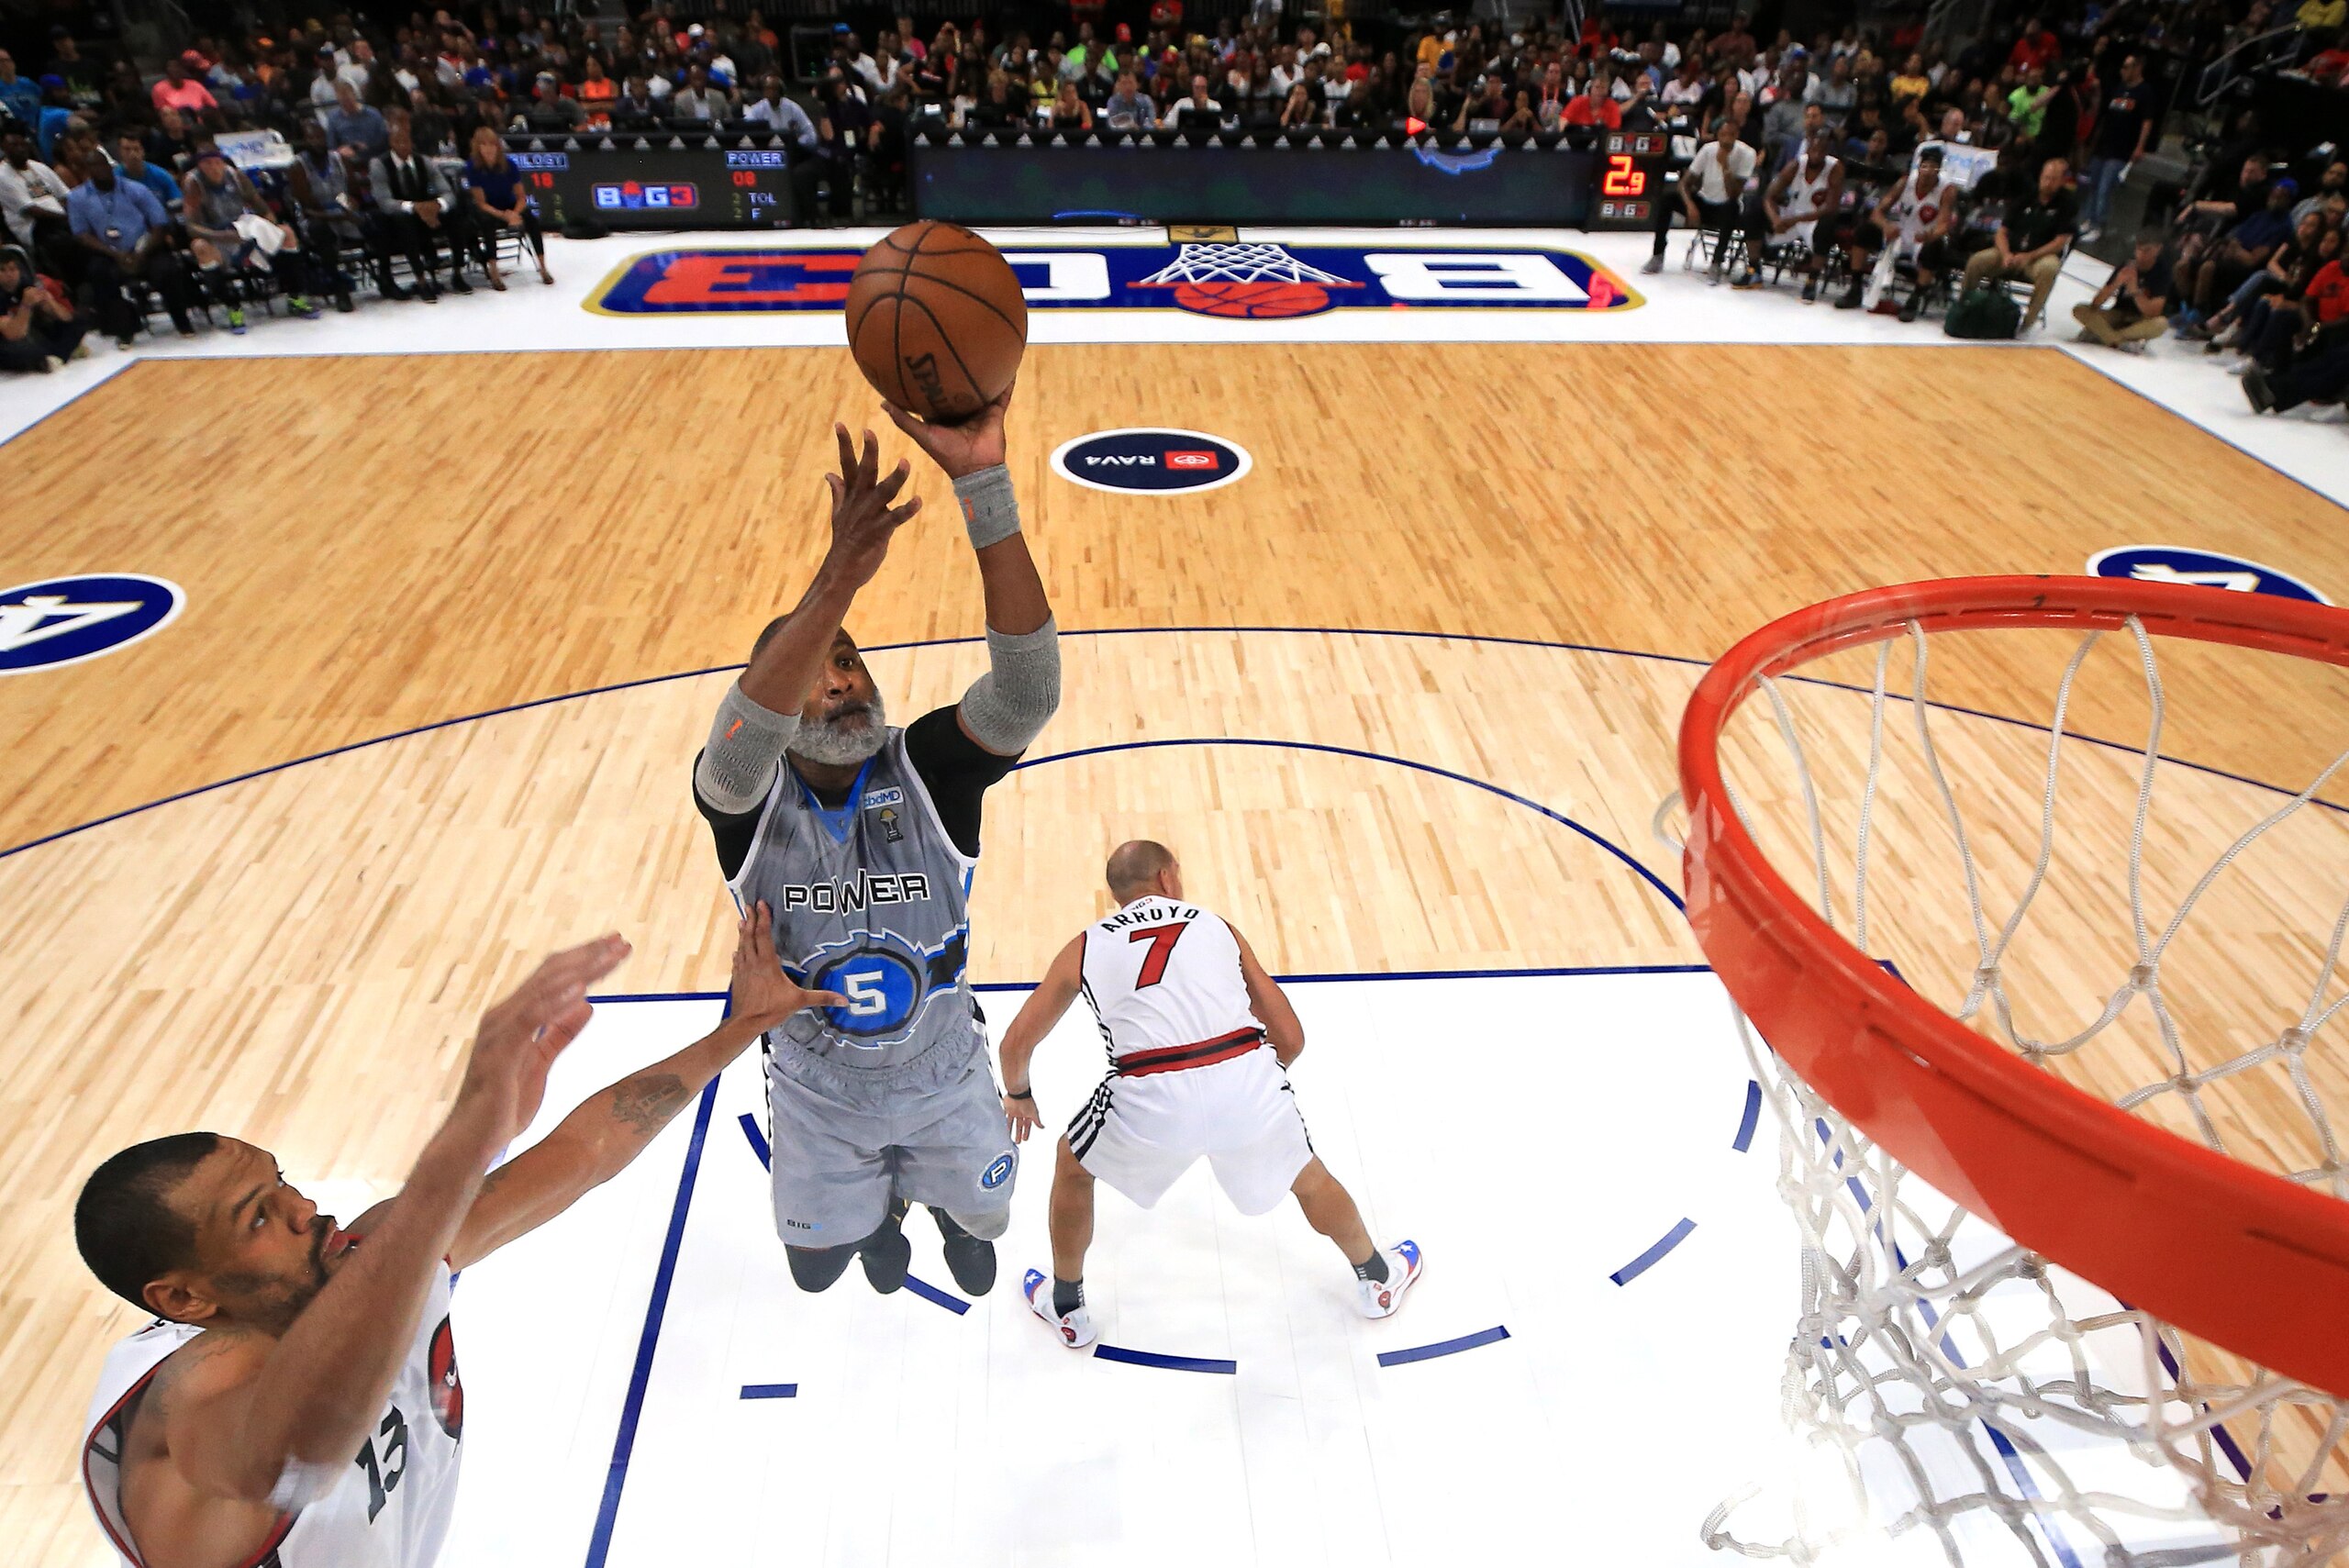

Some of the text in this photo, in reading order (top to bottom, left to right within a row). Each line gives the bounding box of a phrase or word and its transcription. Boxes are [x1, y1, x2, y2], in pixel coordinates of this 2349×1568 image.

[728, 152, 782, 165] POWER
[1085, 455, 1156, 466] RAV4
[784, 868, 930, 917] POWER
[1101, 906, 1199, 933] ARROYO
[1130, 921, 1190, 991] 7
[844, 970, 888, 1015] 5
[989, 1162, 1007, 1184] P
